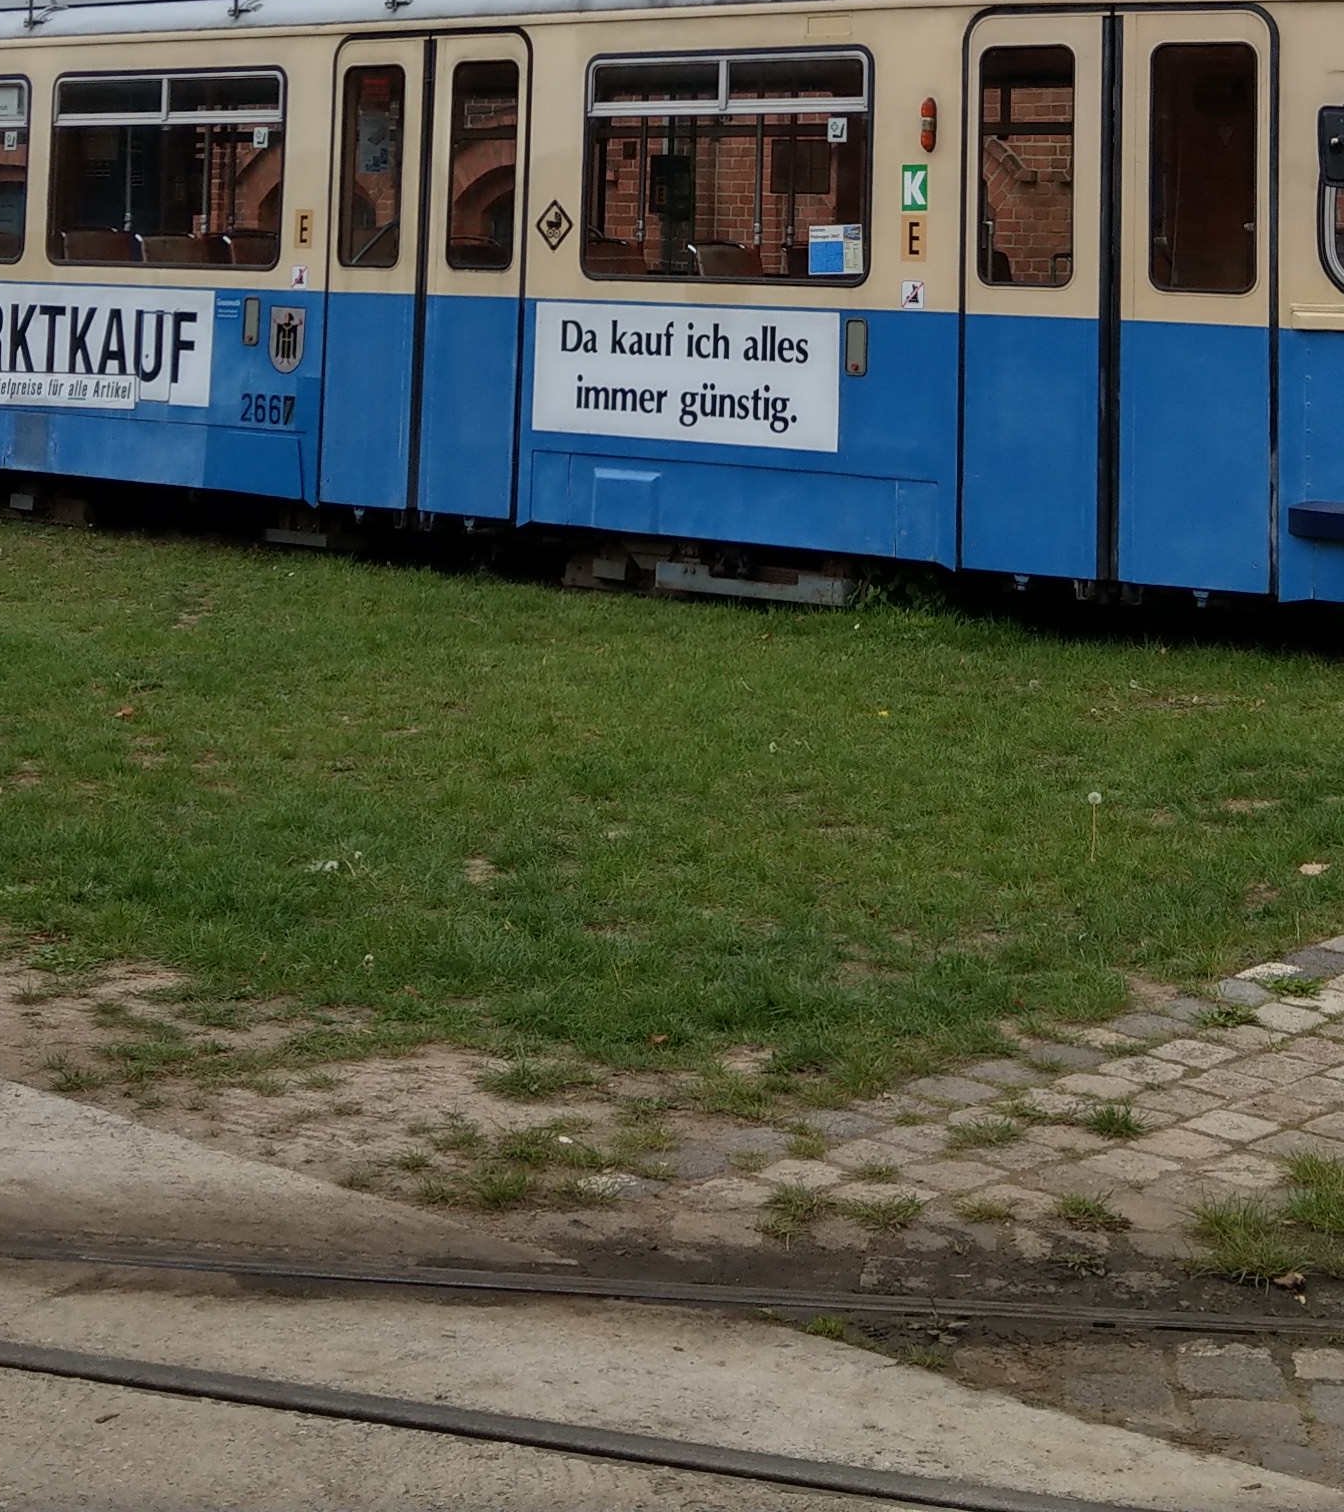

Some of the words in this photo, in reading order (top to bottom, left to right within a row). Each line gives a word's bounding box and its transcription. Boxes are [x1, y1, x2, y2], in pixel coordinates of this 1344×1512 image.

[903, 170, 927, 206] K
[299, 214, 309, 243] E
[908, 221, 920, 255] E
[560, 319, 598, 354] Da
[610, 319, 675, 358] kauf
[685, 322, 731, 361] ich
[743, 325, 810, 364] alles
[47, 379, 64, 397] für
[67, 379, 88, 397] alle
[92, 380, 133, 400] Artikel
[574, 374, 669, 414] immer
[678, 382, 799, 434] günstig.
[240, 392, 296, 426] 2667
